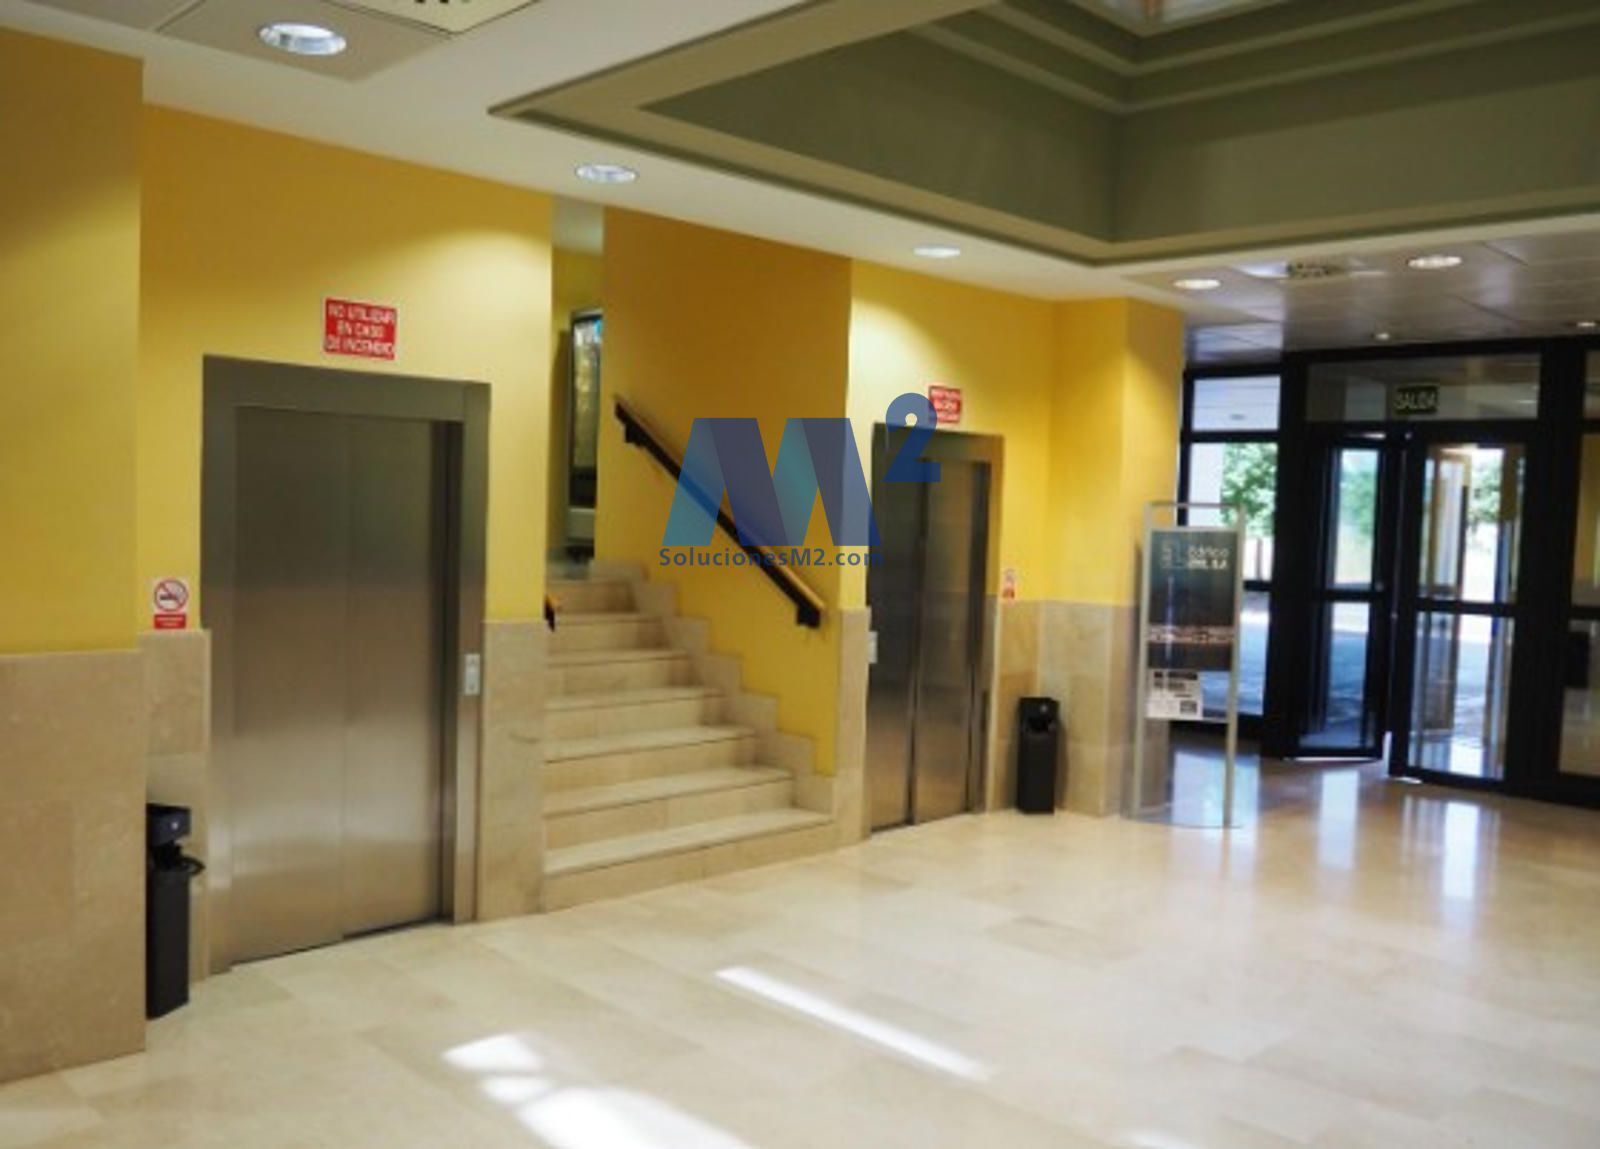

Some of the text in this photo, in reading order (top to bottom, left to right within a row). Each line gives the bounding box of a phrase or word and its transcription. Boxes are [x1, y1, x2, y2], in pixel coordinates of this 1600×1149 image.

[337, 320, 385, 338] EN CASO
[1394, 390, 1437, 409] SALIDA
